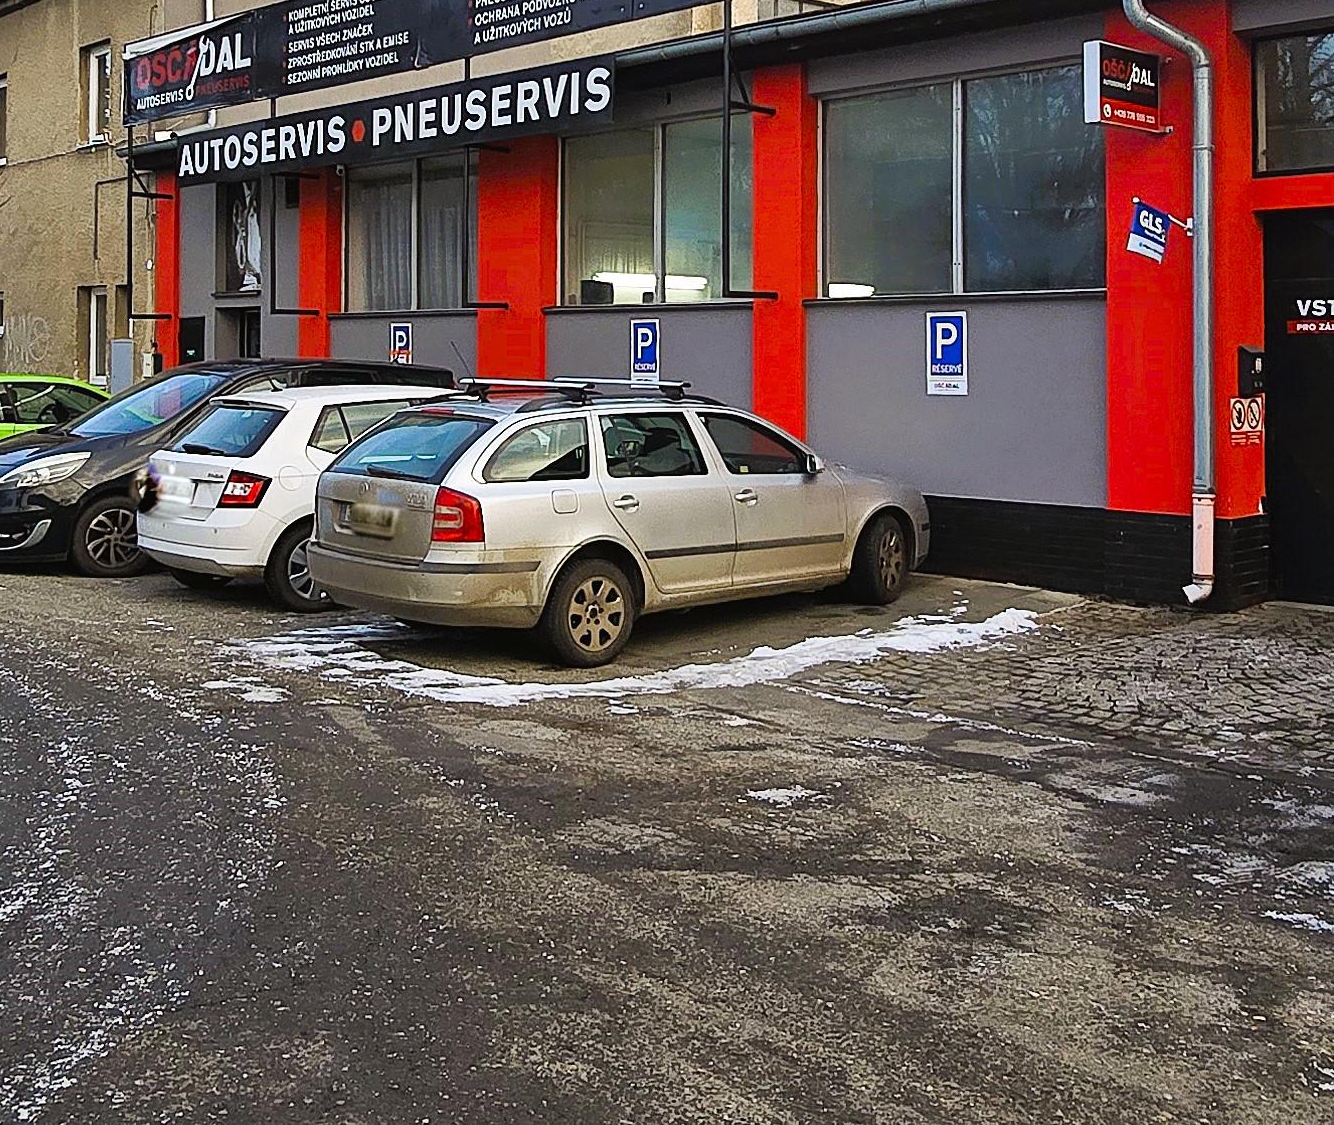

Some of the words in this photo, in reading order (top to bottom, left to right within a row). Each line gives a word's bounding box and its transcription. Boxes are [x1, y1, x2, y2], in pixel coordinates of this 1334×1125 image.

[288, 0, 329, 22] KOMPLETNÍ
[288, 24, 294, 35] A
[295, 13, 340, 33] UŽITKOVÝCH
[342, 4, 374, 22] VOZIDEL
[474, 32, 480, 44] A
[483, 18, 541, 42] UŽITKOVÝCH
[543, 8, 571, 27] VOZŮ
[475, 4, 519, 26] OCHRANA
[288, 36, 314, 53] SERVIS
[316, 31, 340, 46] VŠECH
[342, 23, 373, 41] ZNAČEK
[288, 41, 358, 69] ZPROSTŘEDKOVÁNÍ
[359, 40, 375, 53] STK
[376, 38, 381, 49] A
[383, 31, 409, 47] EMISE
[288, 66, 320, 84] SEZONNÍ
[322, 58, 363, 77] PROHLÍDKY
[365, 52, 398, 68] VOZIDEL
[137, 88, 183, 109] AUTOSERVIS
[179, 115, 346, 176] AUTOSERVIS
[372, 67, 612, 146] PNEUSERVIS
[1139, 210, 1163, 234] GLS
[396, 331, 407, 350] P
[936, 323, 957, 359] P
[1297, 323, 1316, 331] PRO
[638, 328, 653, 359] P
